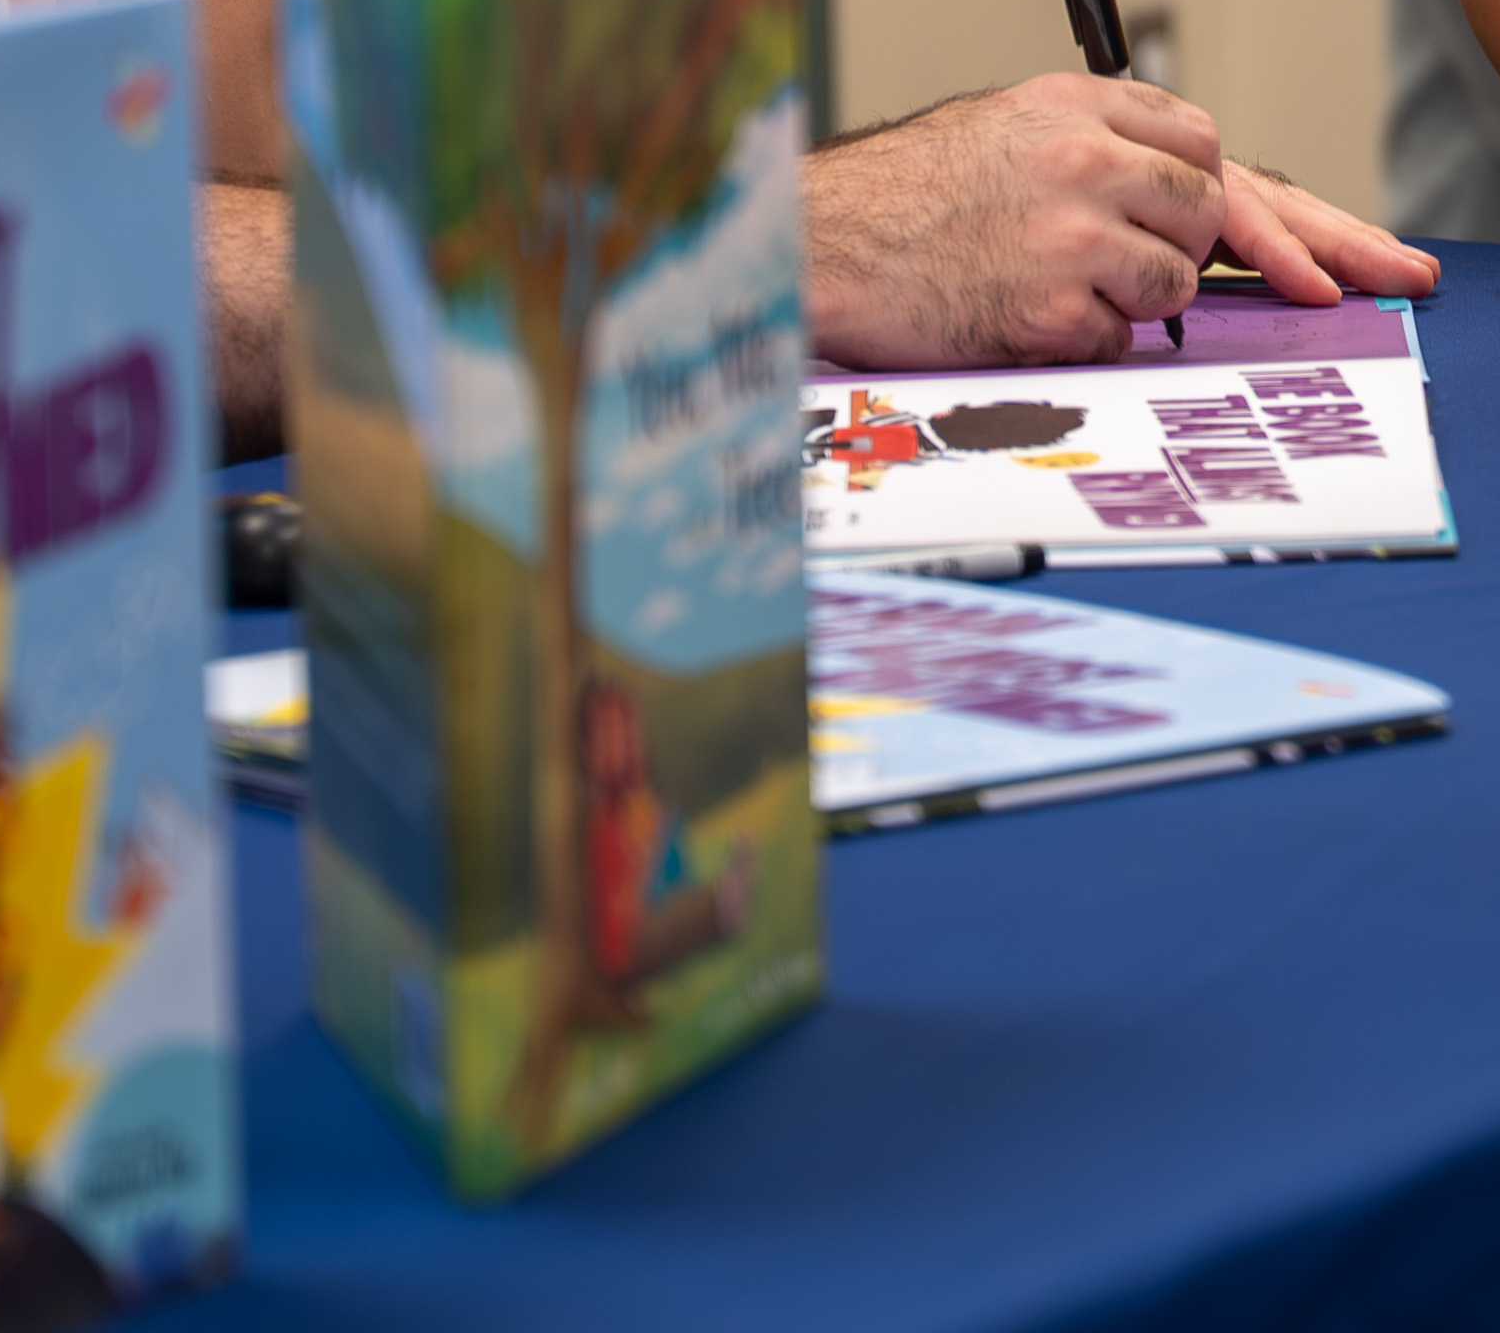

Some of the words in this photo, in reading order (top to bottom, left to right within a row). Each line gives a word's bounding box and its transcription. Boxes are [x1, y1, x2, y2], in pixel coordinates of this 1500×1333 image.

[1238, 367, 1355, 400] THE
[1147, 394, 1269, 439] THAT
[1261, 402, 1388, 460] BOOK
